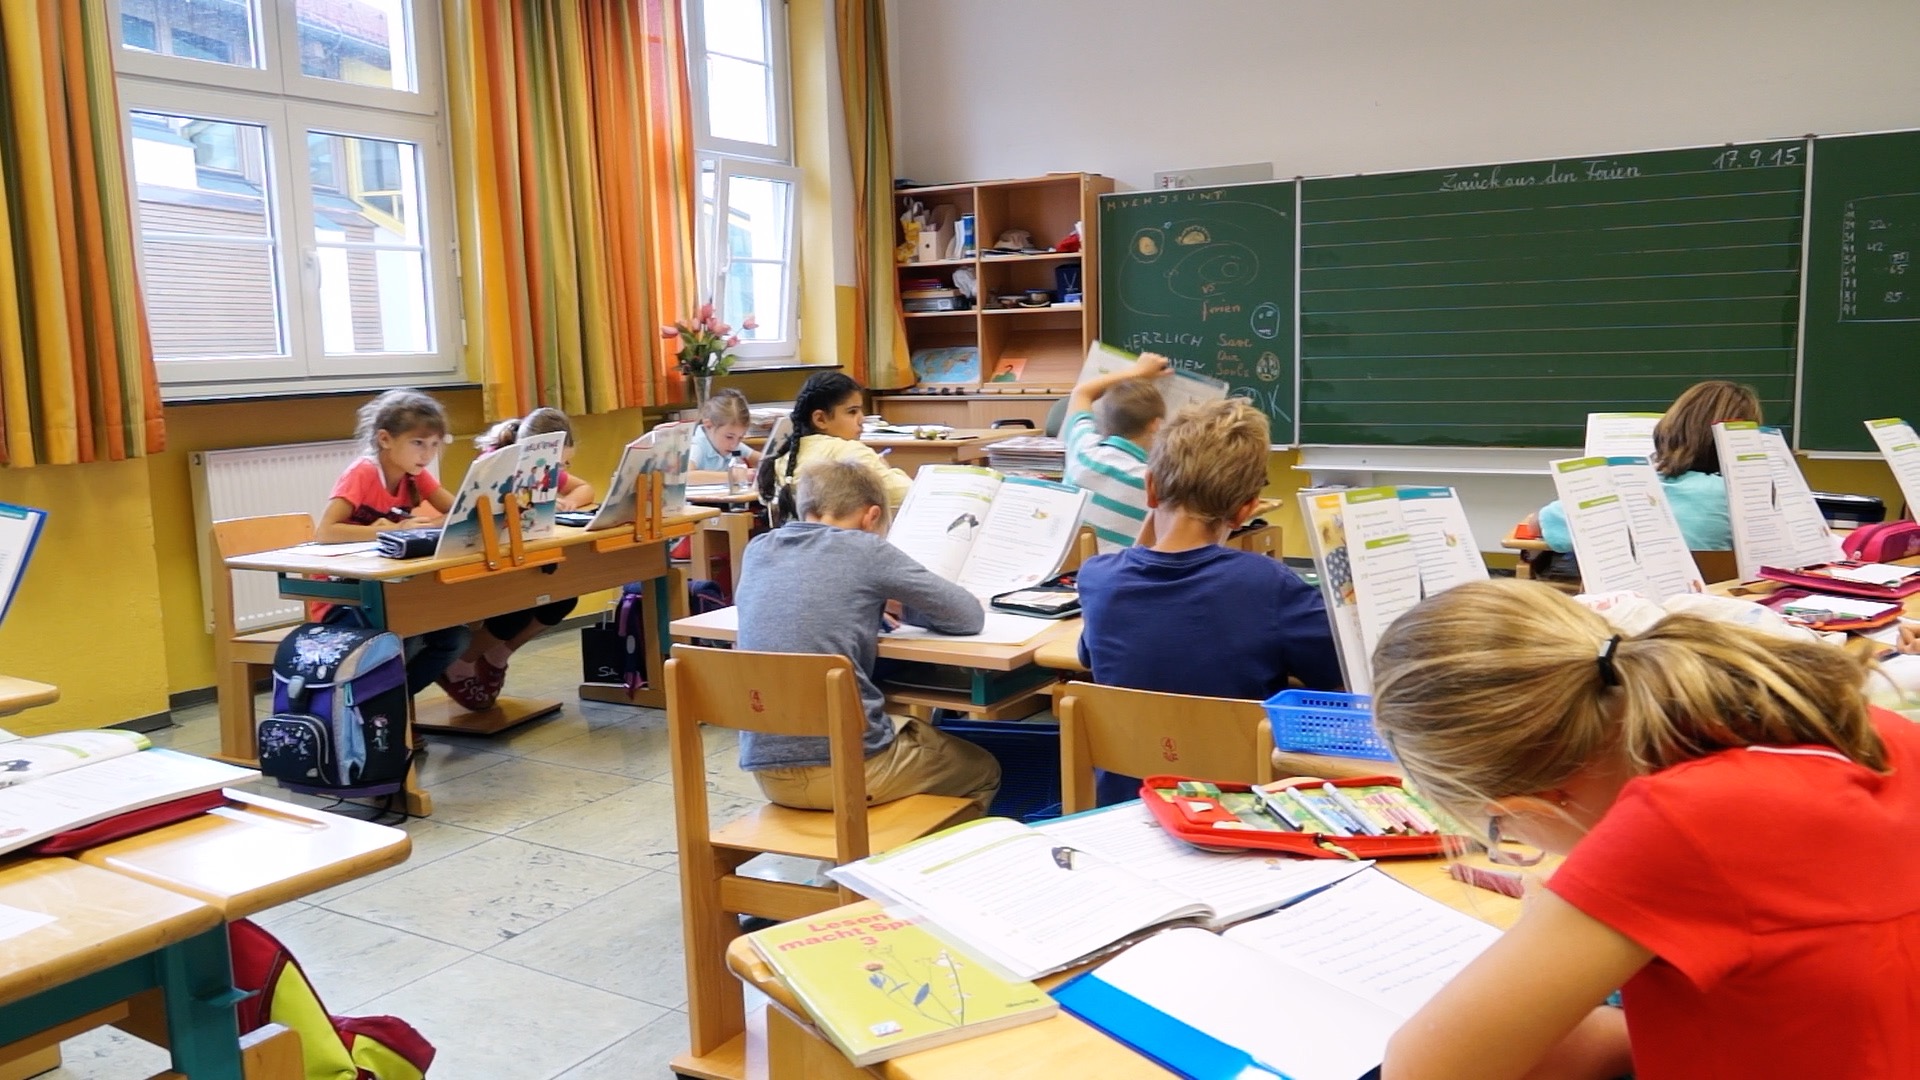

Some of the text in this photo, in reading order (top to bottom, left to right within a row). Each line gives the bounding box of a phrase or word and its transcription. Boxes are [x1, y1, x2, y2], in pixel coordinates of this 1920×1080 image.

[1439, 160, 1641, 192] Zurück aus den Ferien
[1123, 332, 1204, 352] HERZLICH
[807, 913, 889, 932] Lesen
[778, 927, 866, 951] macht
[860, 936, 879, 946] 3
